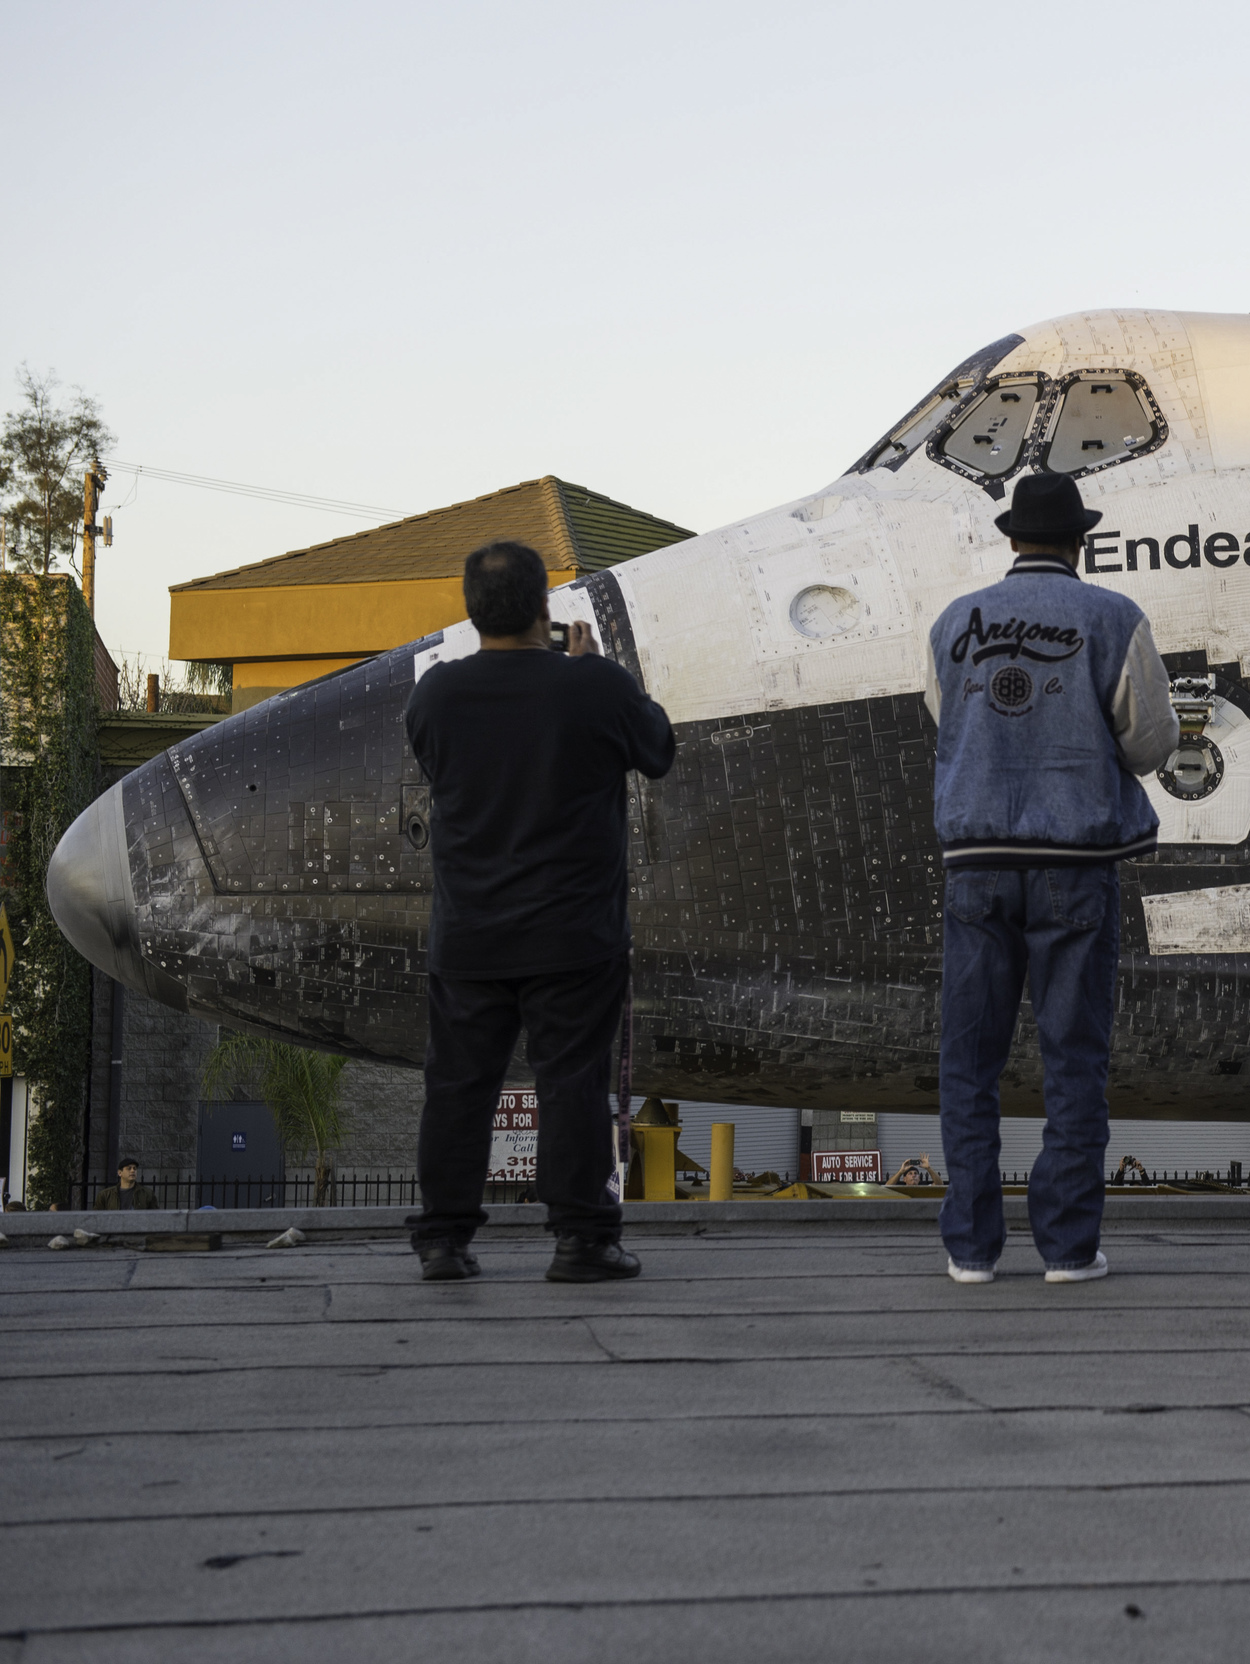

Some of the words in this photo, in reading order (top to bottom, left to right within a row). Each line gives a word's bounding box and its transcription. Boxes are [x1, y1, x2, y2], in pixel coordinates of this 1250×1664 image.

[950, 606, 1084, 666] Arizona
[998, 677, 1026, 699] 88
[1044, 677, 1066, 695] Co.
[512, 1112, 532, 1128] FOR
[513, 1143, 534, 1153] Call
[821, 1156, 841, 1169] AUTO
[844, 1155, 873, 1168] SERVICE
